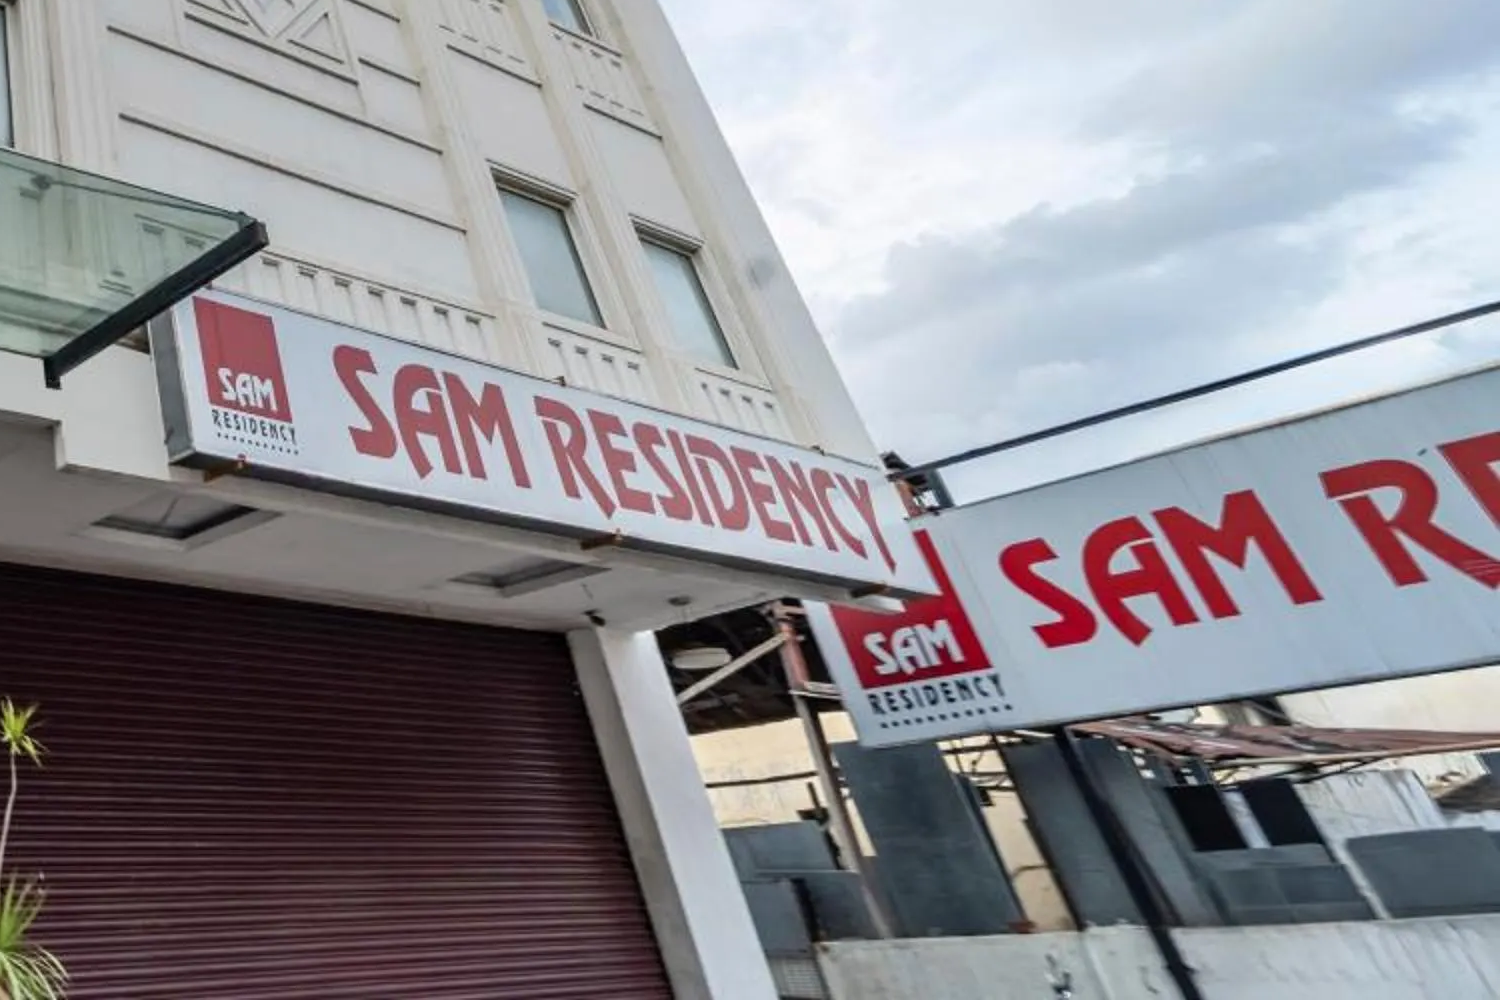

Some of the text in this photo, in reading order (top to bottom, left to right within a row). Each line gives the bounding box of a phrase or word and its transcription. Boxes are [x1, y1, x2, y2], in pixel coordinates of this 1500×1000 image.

[218, 367, 278, 414] SAM
[211, 409, 297, 445] RESIDENCY
[332, 344, 898, 575] SAM RESIDENCY
[999, 489, 1324, 650] SAM
[863, 619, 966, 676] SAM
[867, 673, 1005, 716] RESIDENCY
